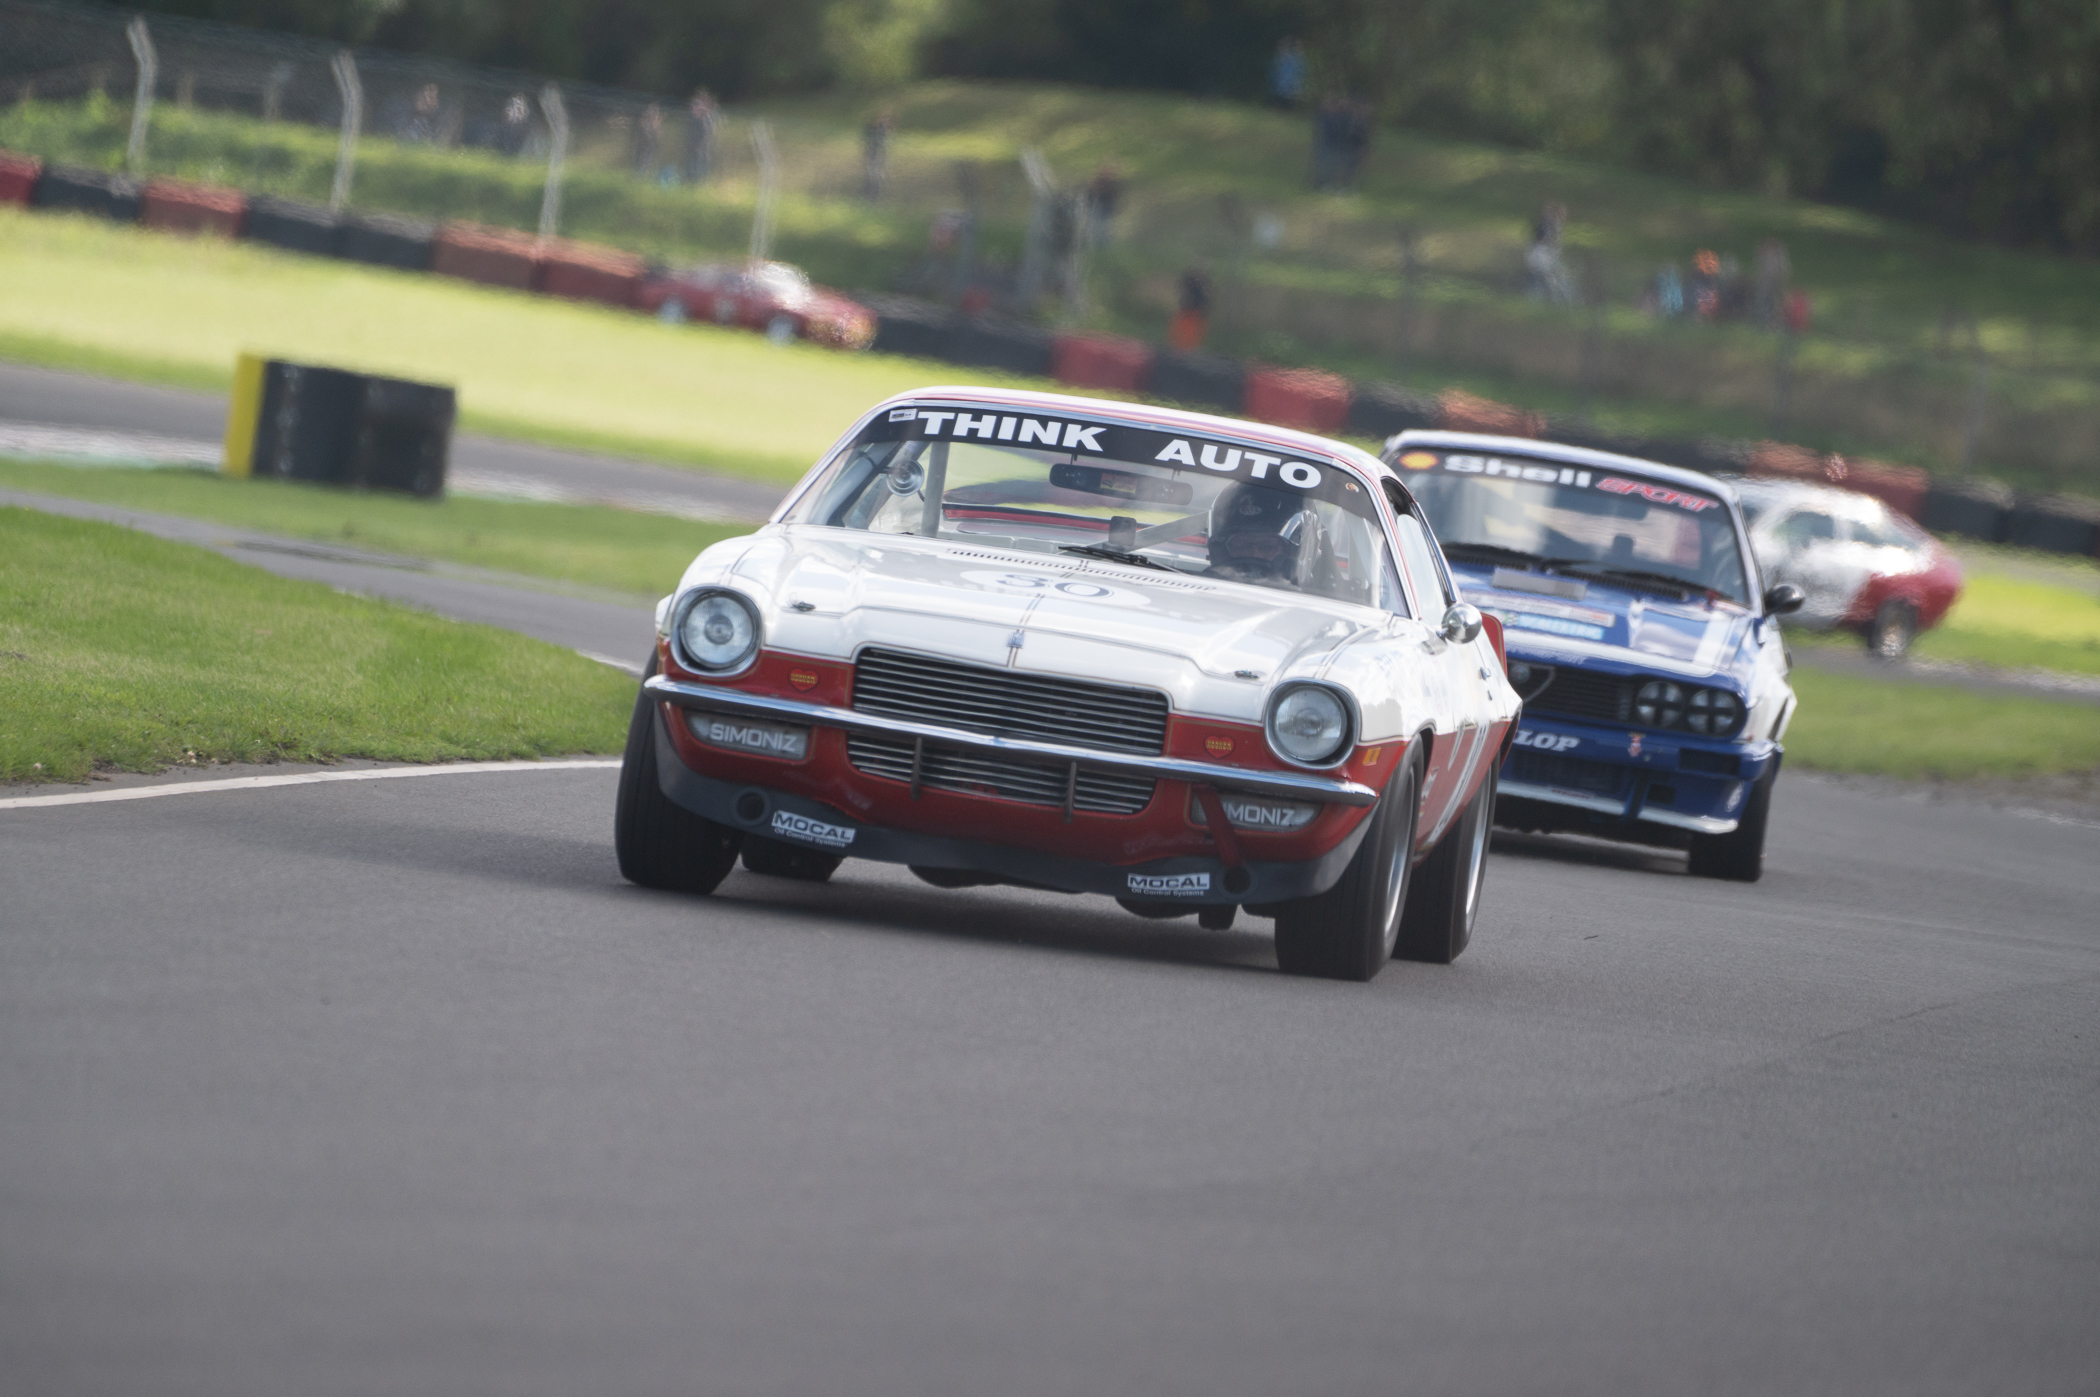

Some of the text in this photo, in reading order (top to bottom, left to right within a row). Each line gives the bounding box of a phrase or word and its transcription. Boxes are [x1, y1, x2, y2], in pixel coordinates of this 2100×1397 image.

[917, 411, 1107, 452] THINK
[1154, 438, 1322, 489] AUTO
[1444, 454, 1719, 512] Shell SPORT
[995, 573, 1115, 598] 30
[710, 723, 798, 752] SIMONIZ
[1512, 729, 1581, 752] LOP
[774, 813, 852, 841] MOCAL
[1222, 801, 1296, 827] IMONIZ
[1129, 876, 1209, 889] MOCAL
[1172, 889, 1205, 897] Systems
